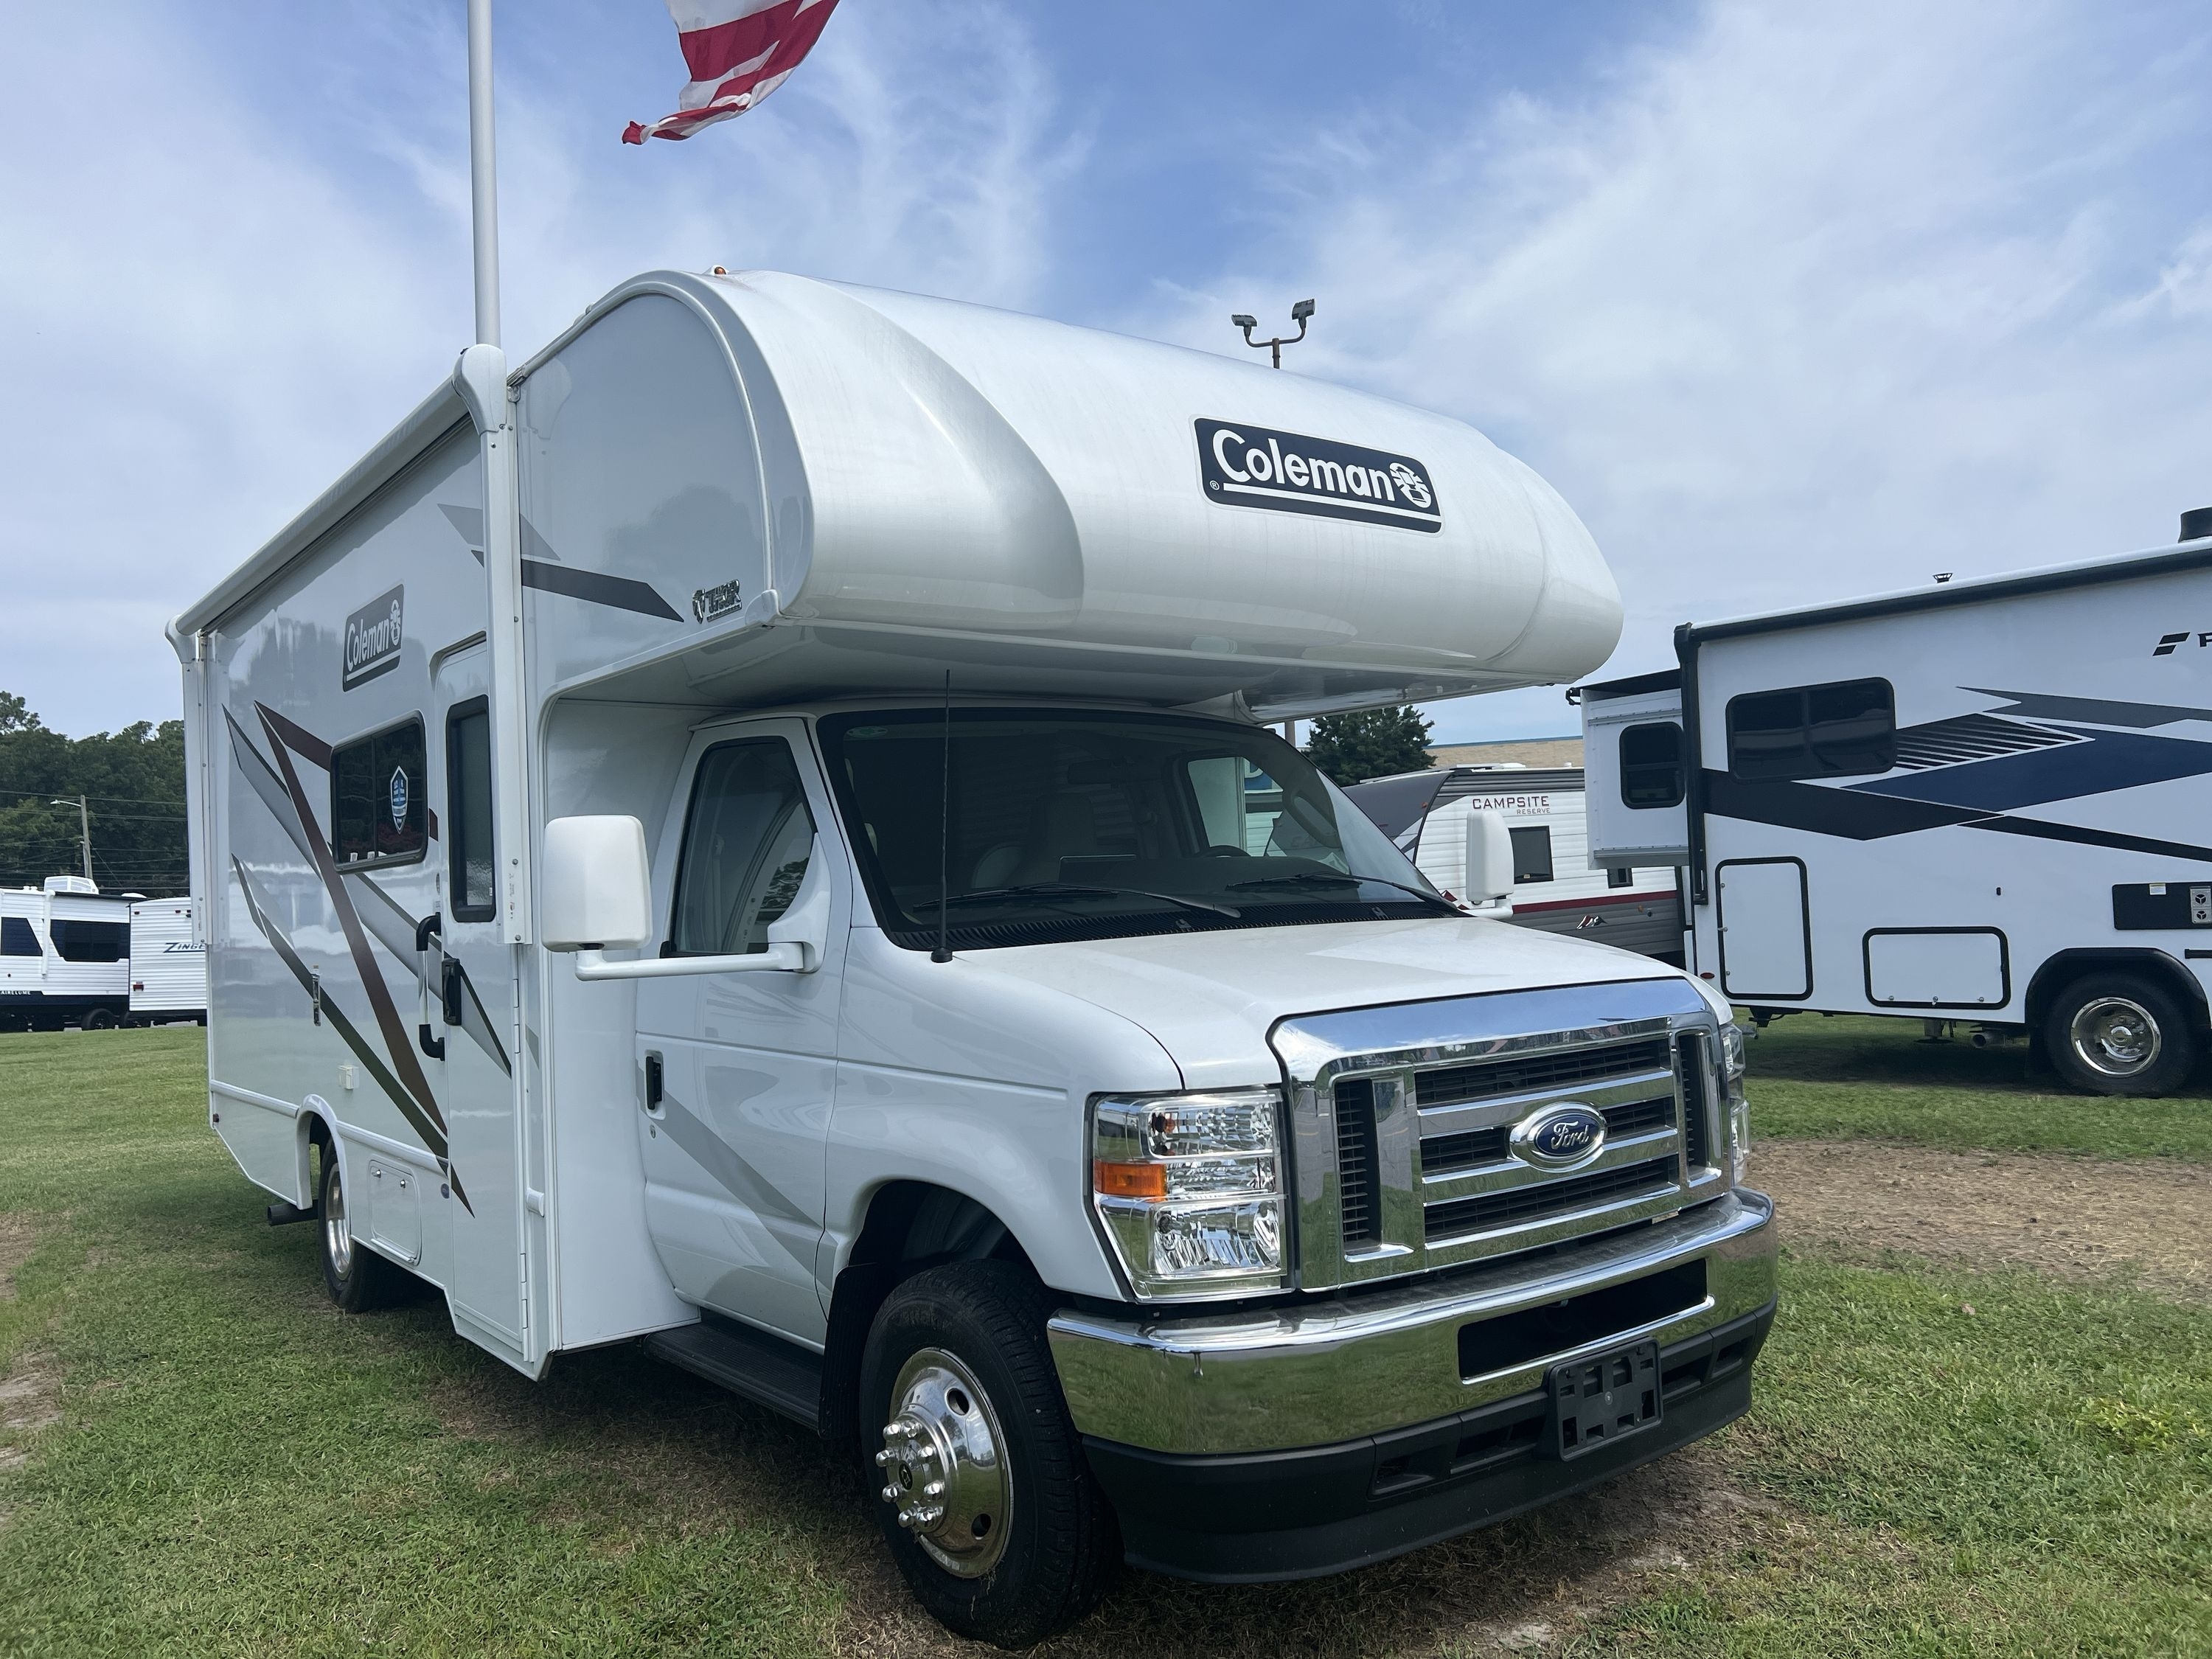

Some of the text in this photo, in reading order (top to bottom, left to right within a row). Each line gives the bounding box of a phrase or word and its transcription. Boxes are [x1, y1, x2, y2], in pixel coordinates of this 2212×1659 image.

[1213, 429, 1395, 501] Coleman
[347, 619, 390, 672] Coleman
[1472, 796, 1550, 810] CAMPSITE
[1551, 1121, 1590, 1150] Ford
